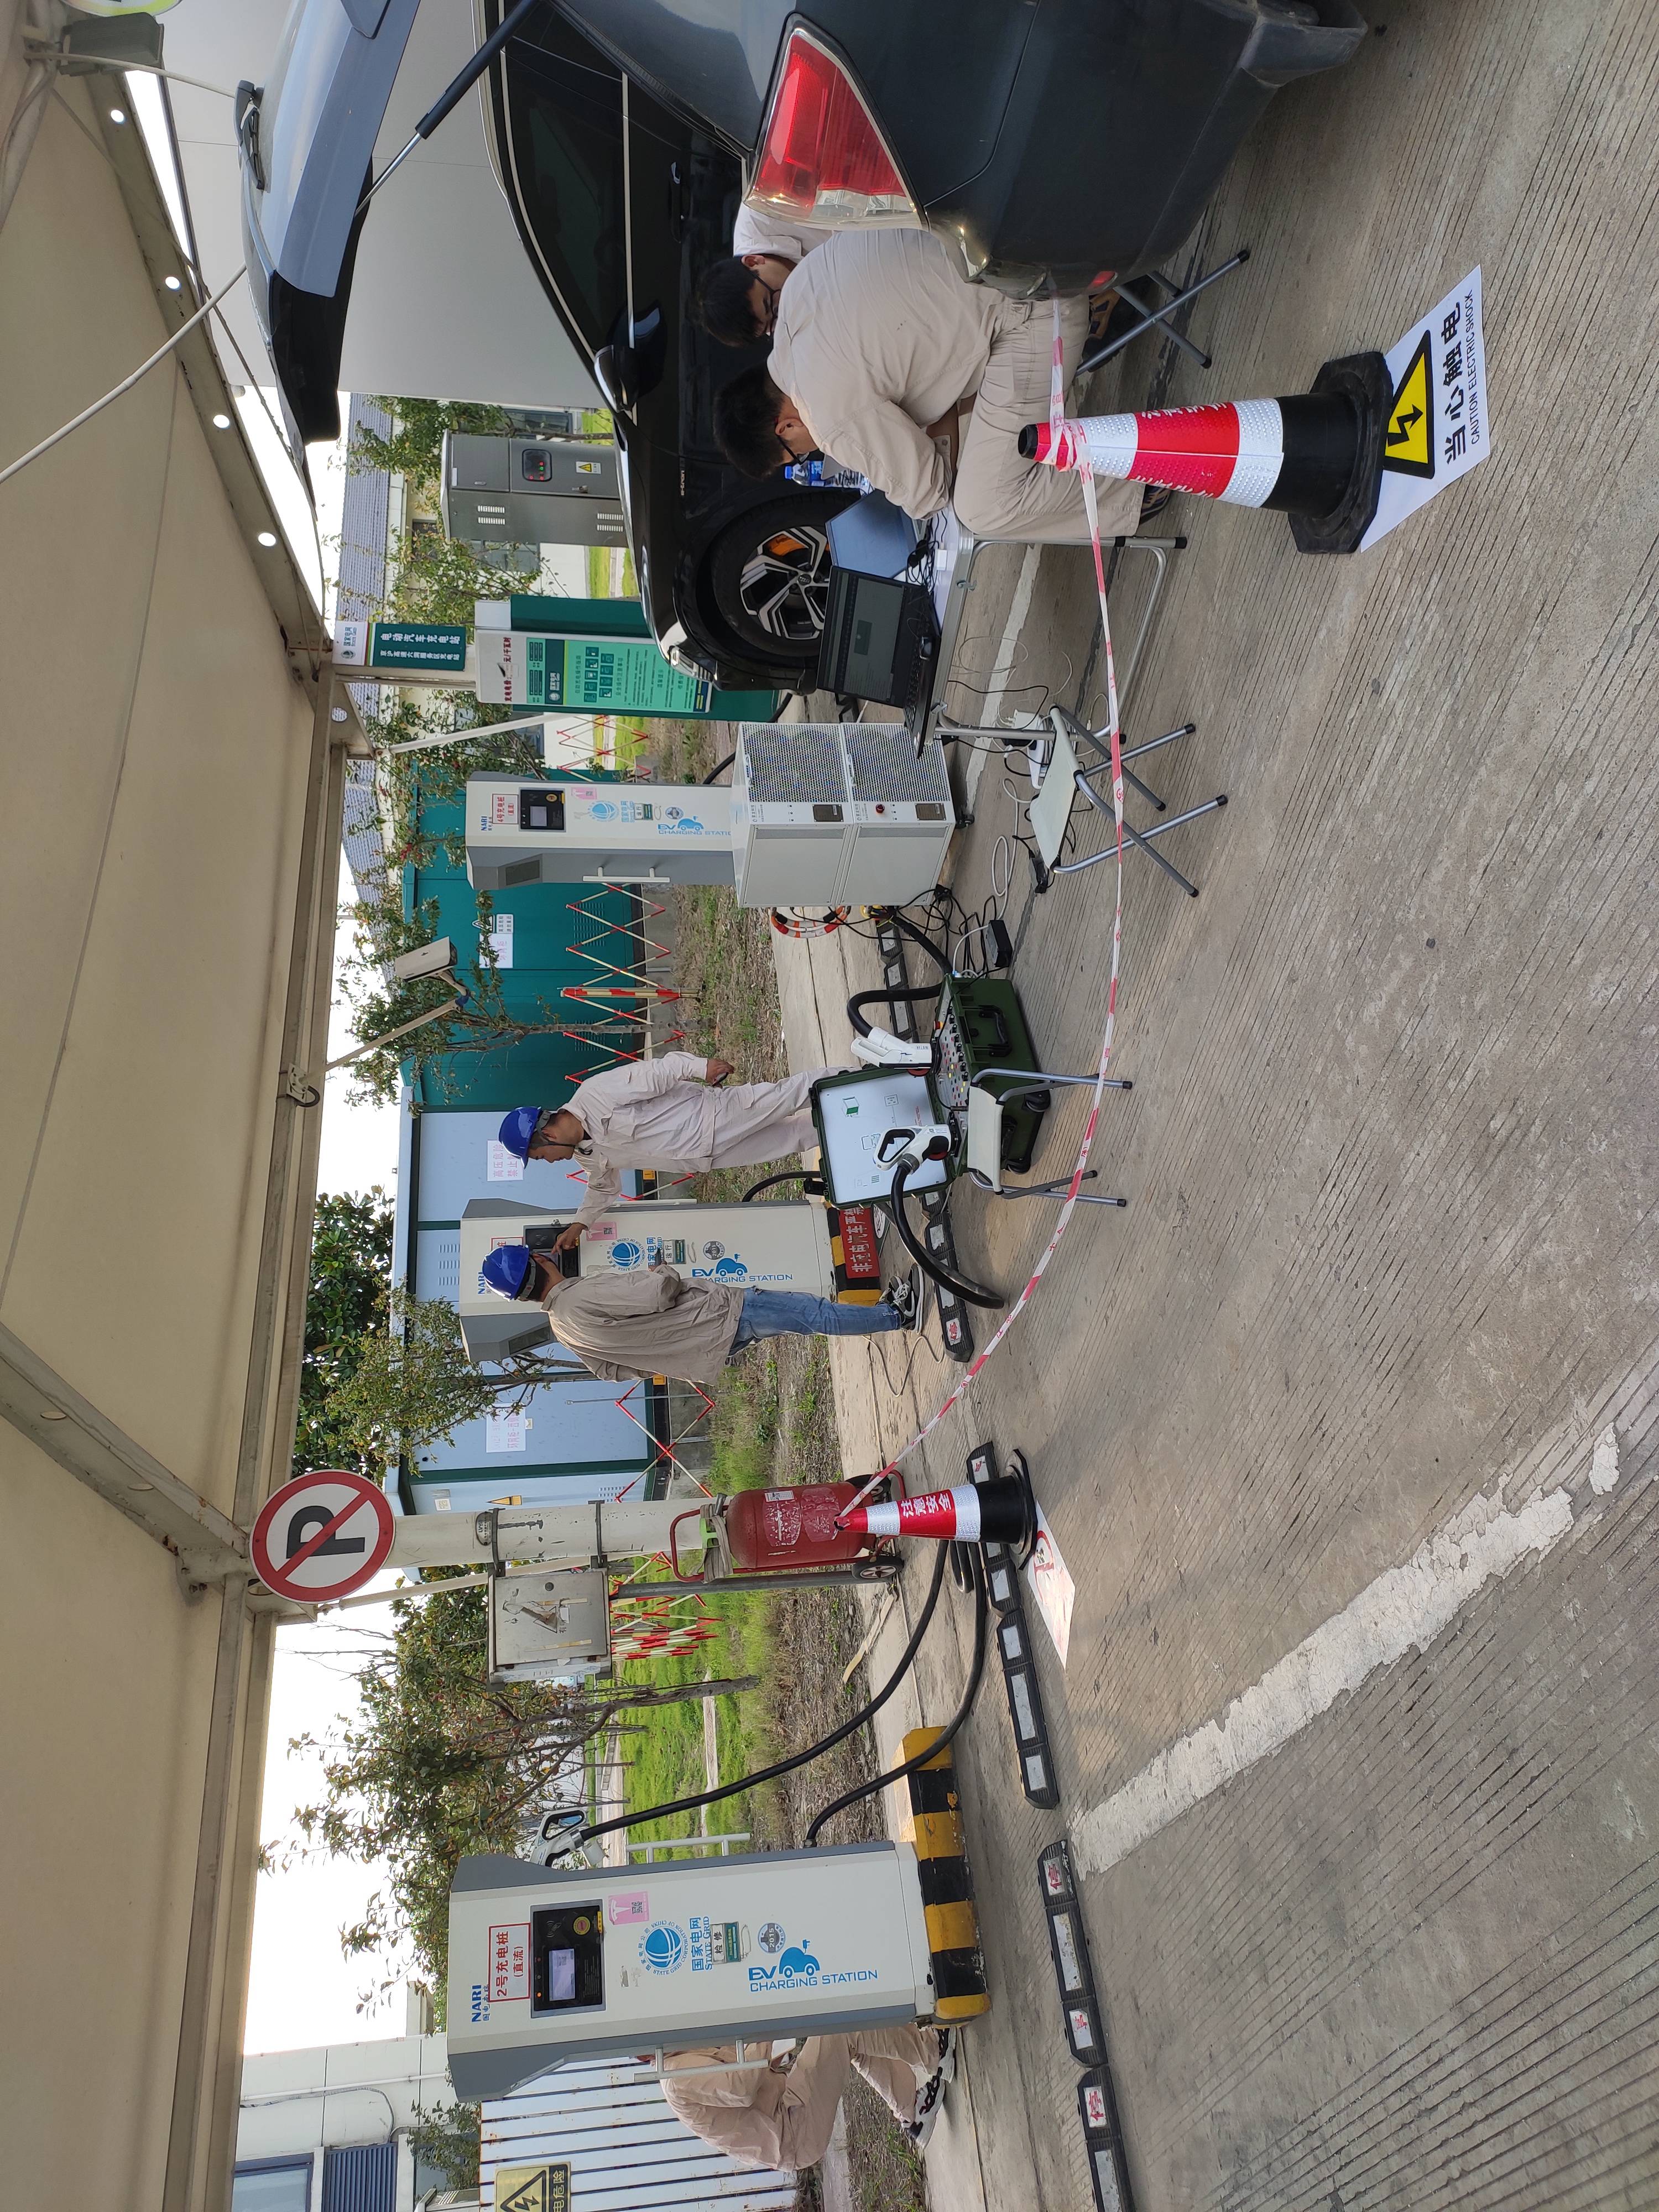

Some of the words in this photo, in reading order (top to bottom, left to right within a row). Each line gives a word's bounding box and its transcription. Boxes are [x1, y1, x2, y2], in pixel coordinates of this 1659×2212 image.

[1464, 289, 1474, 332] SHOCK
[1466, 332, 1477, 390] ELECTRIC
[1441, 302, 1466, 465] 当心触电
[1469, 392, 1480, 445] CAUTION
[343, 627, 352, 646] 国家电网
[380, 633, 461, 644] 电动汽车充电站
[497, 796, 505, 822] 4号充电桩
[665, 1245, 672, 1259] 运行
[692, 1268, 714, 1277] EV
[900, 1493, 952, 1518] 注意安全
[703, 1916, 711, 1939] GRID
[638, 1927, 651, 1970] 国家电网公司
[690, 1917, 705, 1971] 国家电网
[705, 1942, 713, 1970] STATE
[713, 1931, 723, 1954] 检修
[495, 1931, 509, 1997] 2号充电桩
[748, 1965, 778, 1981] EV
[750, 1976, 818, 1992] CHARGING
[822, 1969, 878, 1984] STATION
[471, 1984, 482, 2022] NARI
[1088, 2090, 1104, 2121] 停
[552, 2169, 565, 2212] 电危险
